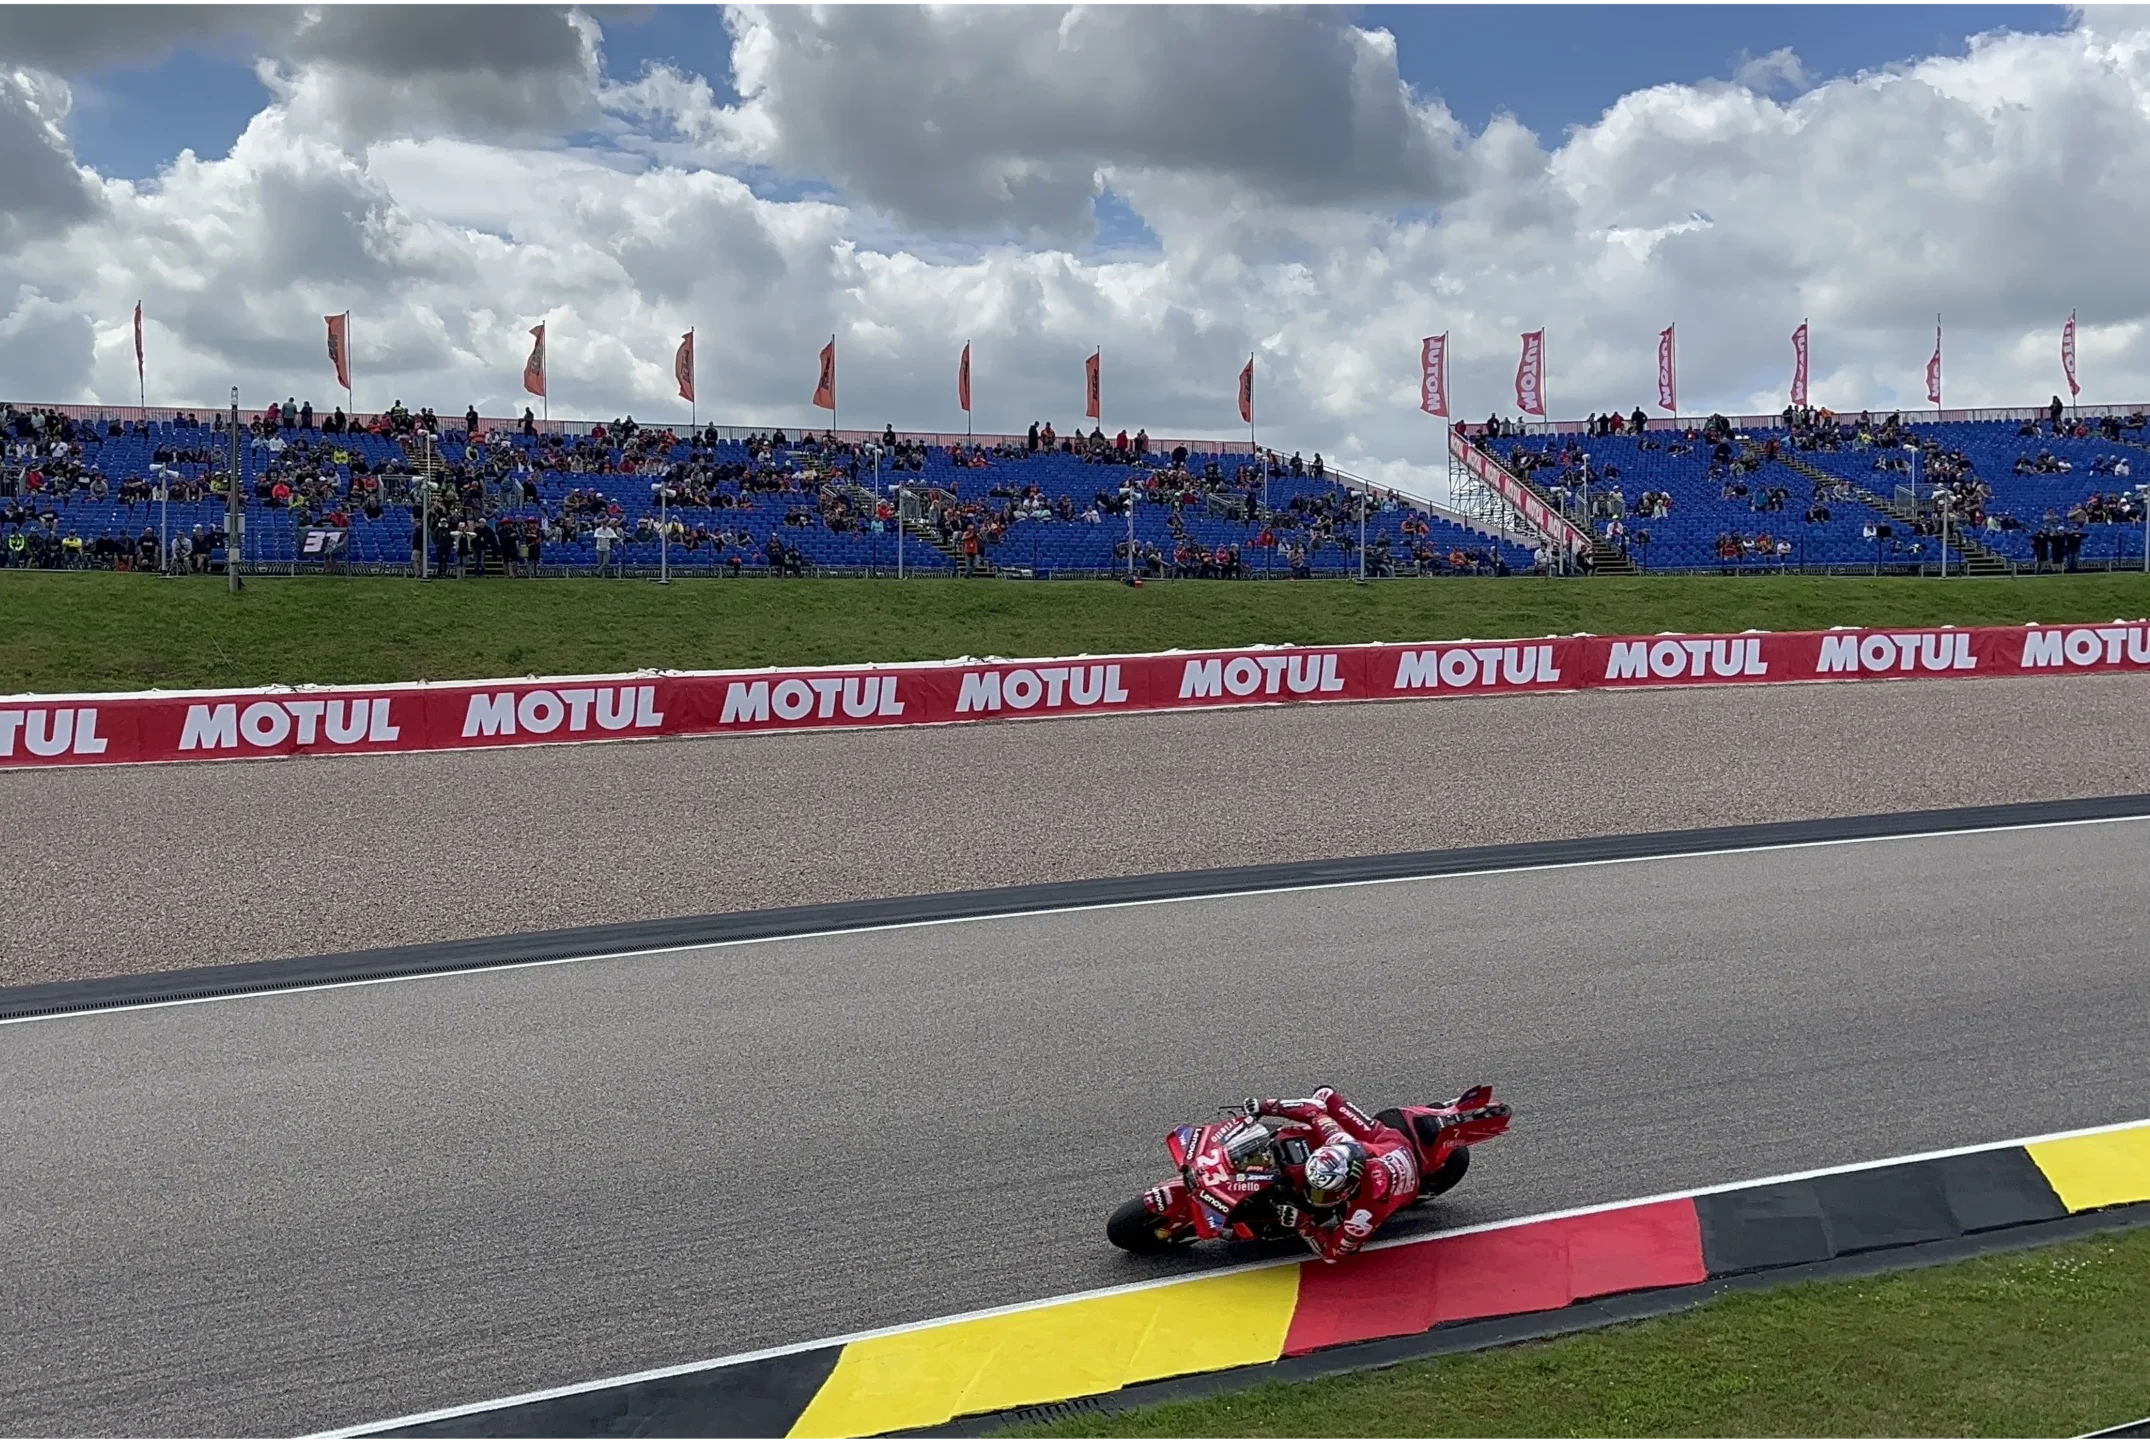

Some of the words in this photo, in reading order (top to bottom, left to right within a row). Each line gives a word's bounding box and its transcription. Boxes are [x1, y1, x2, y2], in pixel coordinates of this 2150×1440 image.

[178, 698, 400, 750] MOTUL
[461, 686, 665, 738] MOTUL
[719, 676, 906, 724] MOTUL
[955, 665, 1129, 713] MOTUL
[1178, 654, 1346, 699] MOTUL
[1394, 645, 1561, 689] MOTUL
[1604, 638, 1768, 680] MOTUL
[1815, 633, 1978, 673] MOTUL
[2020, 627, 2150, 668] MOTU
[1186, 1127, 1202, 1160] Lenovo
[1196, 1148, 1230, 1187] 23
[1152, 1187, 1165, 1212] novo
[1200, 1189, 1229, 1213] Lenovo
